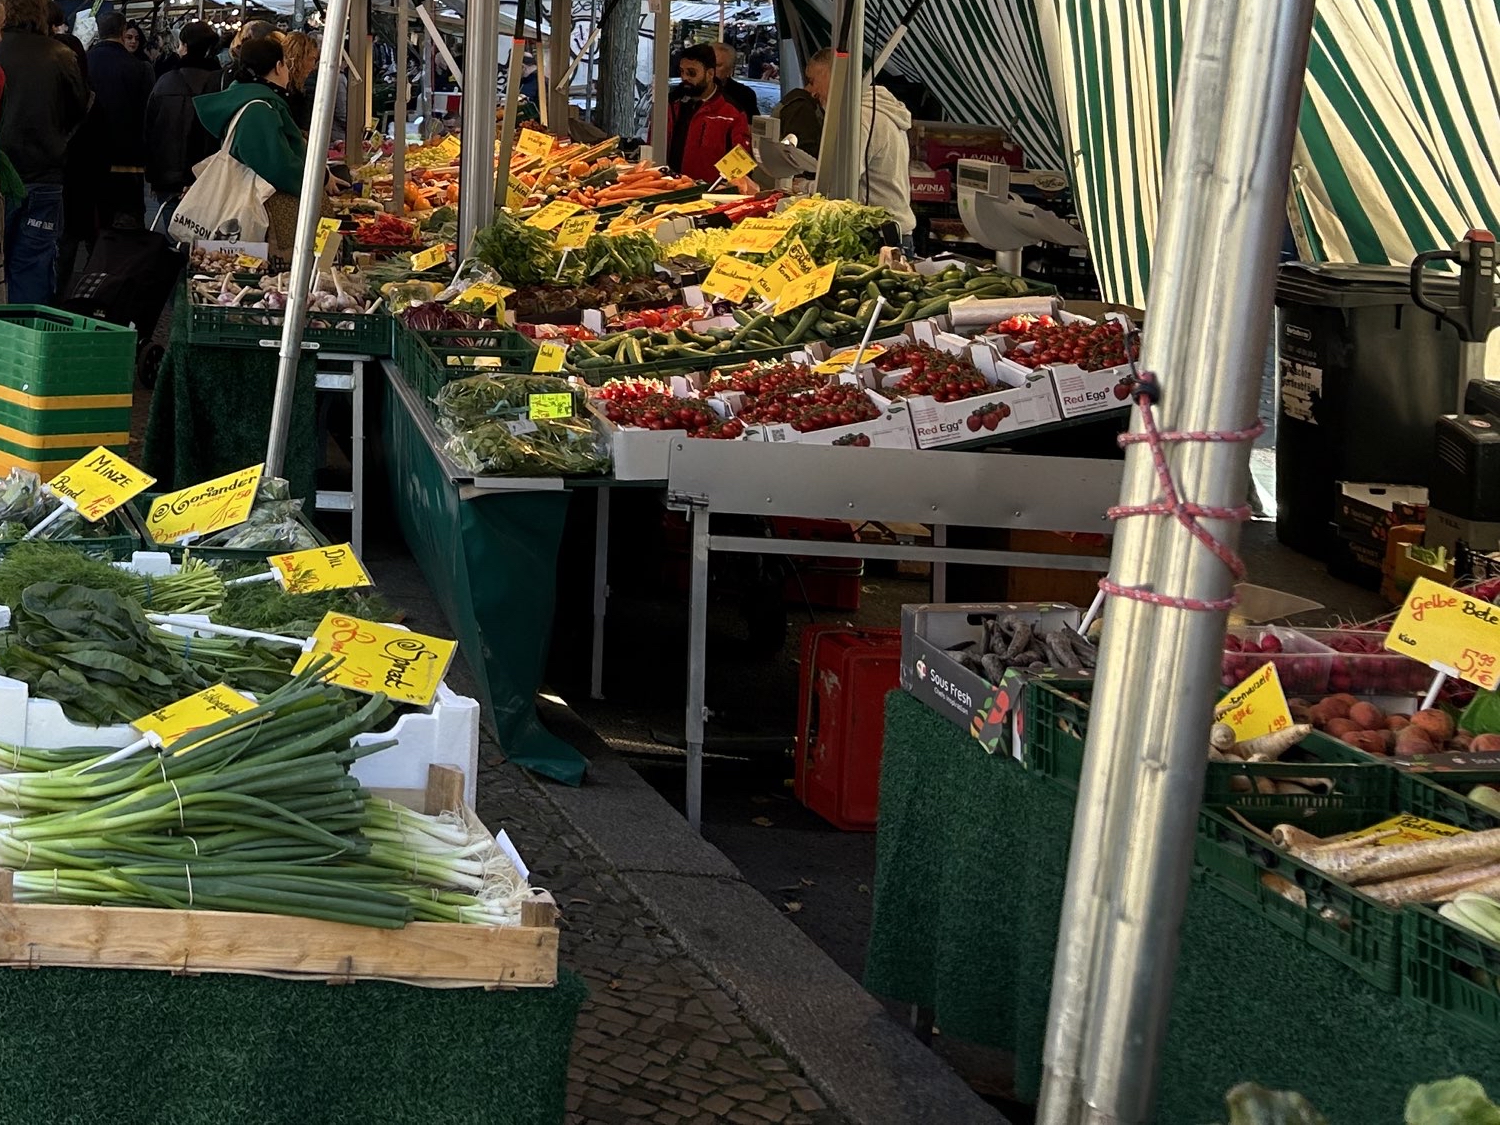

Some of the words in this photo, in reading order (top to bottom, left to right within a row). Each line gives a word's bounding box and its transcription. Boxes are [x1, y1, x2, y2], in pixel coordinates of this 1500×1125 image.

[911, 183, 945, 193] LAVINIA
[173, 213, 212, 240] SAMPSON
[1063, 393, 1084, 406] Red
[1086, 390, 1106, 402] Egg
[917, 425, 938, 437] Red
[940, 421, 960, 433] Egg
[1410, 593, 1458, 622] Gelbe
[1462, 600, 1500, 625] Bete
[929, 668, 949, 692] Sous
[949, 681, 973, 708] Fresh
